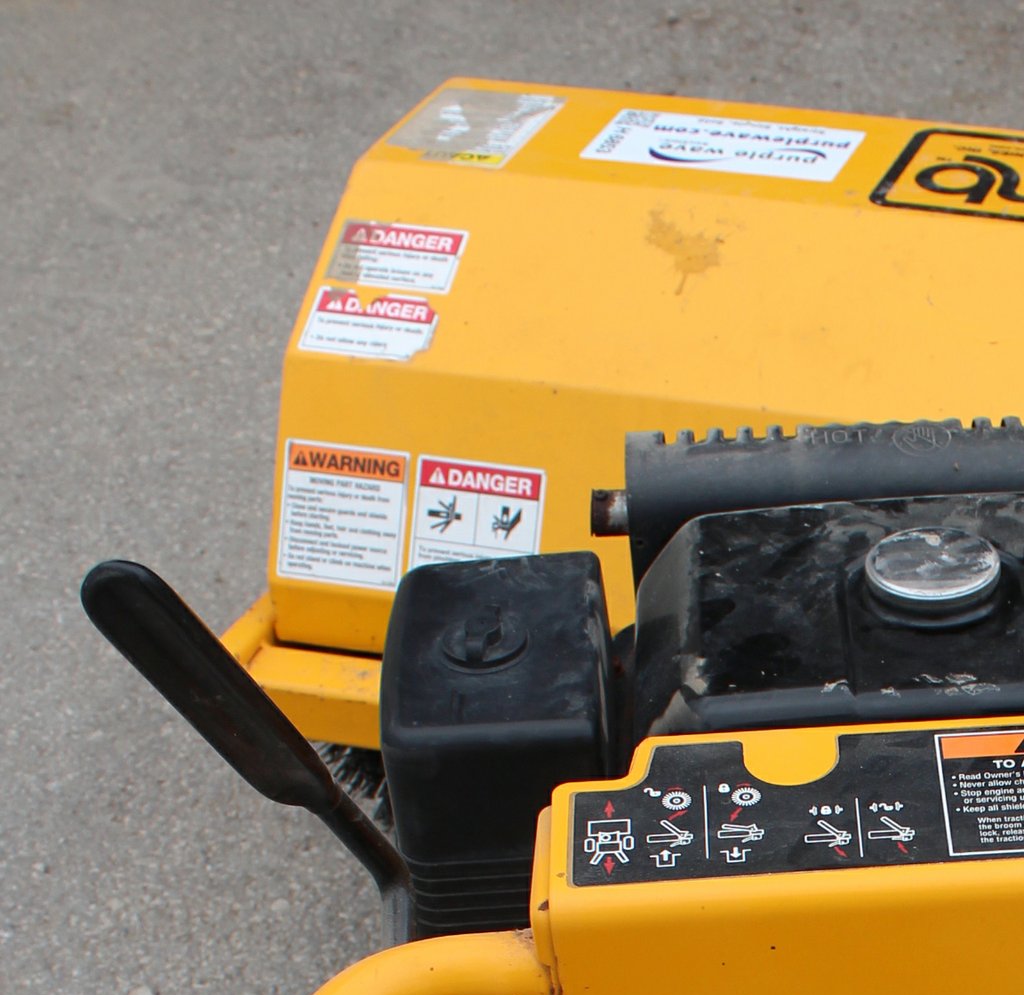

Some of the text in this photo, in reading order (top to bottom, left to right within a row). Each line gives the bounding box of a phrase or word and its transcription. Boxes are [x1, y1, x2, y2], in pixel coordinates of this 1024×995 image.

[654, 125, 850, 148] purplewave.com
[659, 144, 818, 164] purple wave
[369, 229, 454, 252] DANGER
[811, 428, 867, 444] HOT
[309, 452, 400, 477] WARNING
[448, 468, 532, 496] DANGER
[992, 759, 1016, 768] TO
[958, 773, 981, 781] Read
[984, 772, 1020, 780] Owner's
[960, 781, 985, 789] Never
[988, 778, 1012, 787] allow
[960, 790, 982, 798] Stop
[984, 788, 1014, 796] engine
[976, 794, 1016, 804] servicing
[963, 805, 986, 813] Keep
